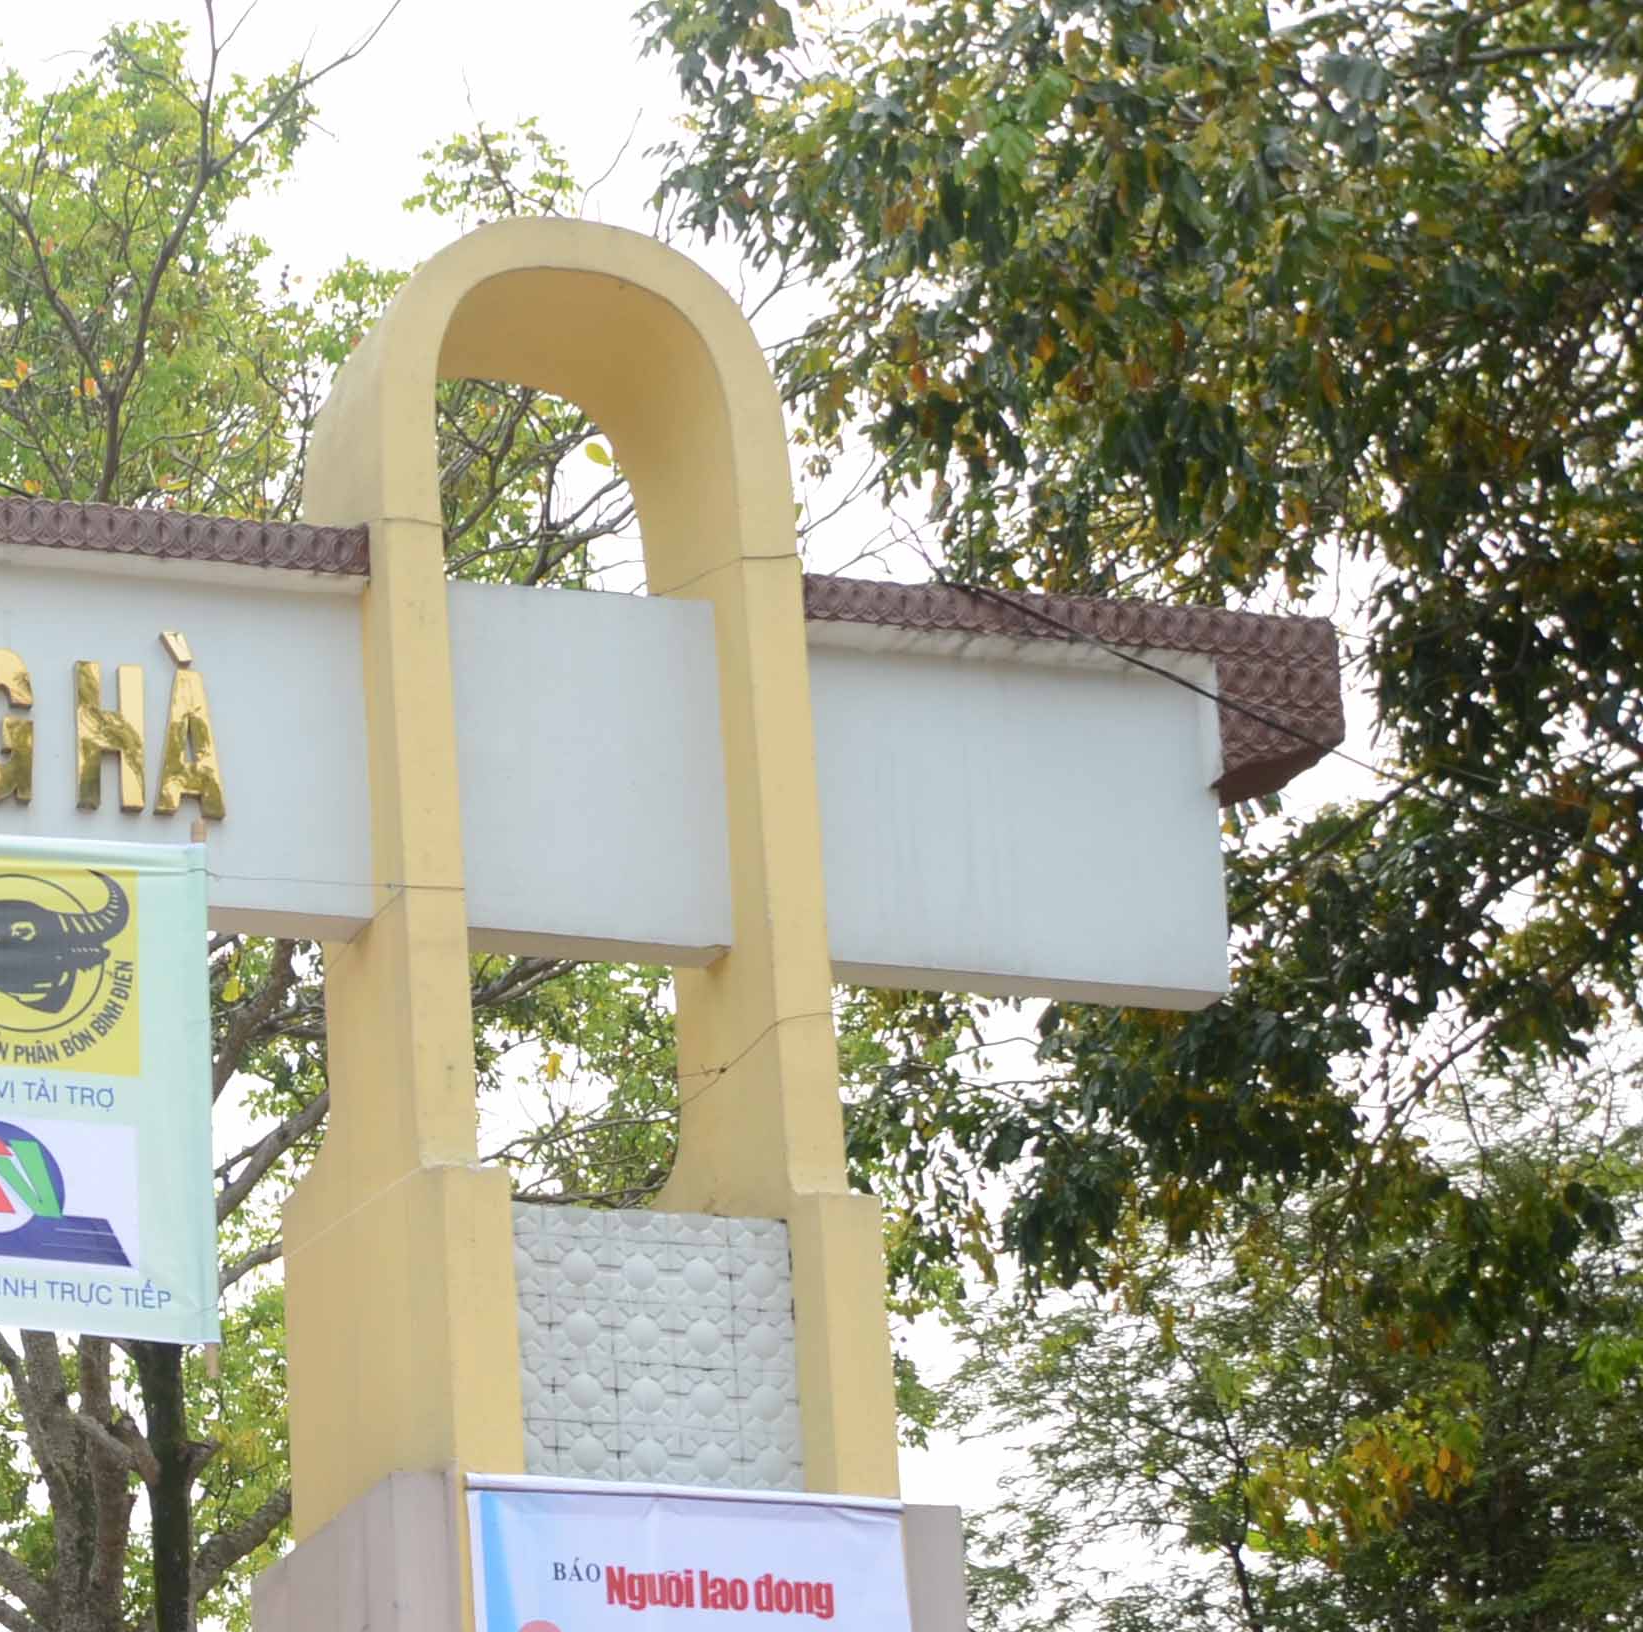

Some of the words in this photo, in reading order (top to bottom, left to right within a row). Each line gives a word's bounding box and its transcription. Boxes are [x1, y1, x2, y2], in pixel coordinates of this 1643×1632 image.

[74, 629, 225, 820] HÀ
[23, 1077, 57, 1103] TÀI
[65, 1083, 113, 1112] TRỢ
[45, 1280, 112, 1307] TRỰC
[120, 1280, 172, 1309] TIẾP
[699, 1570, 748, 1610] lao
